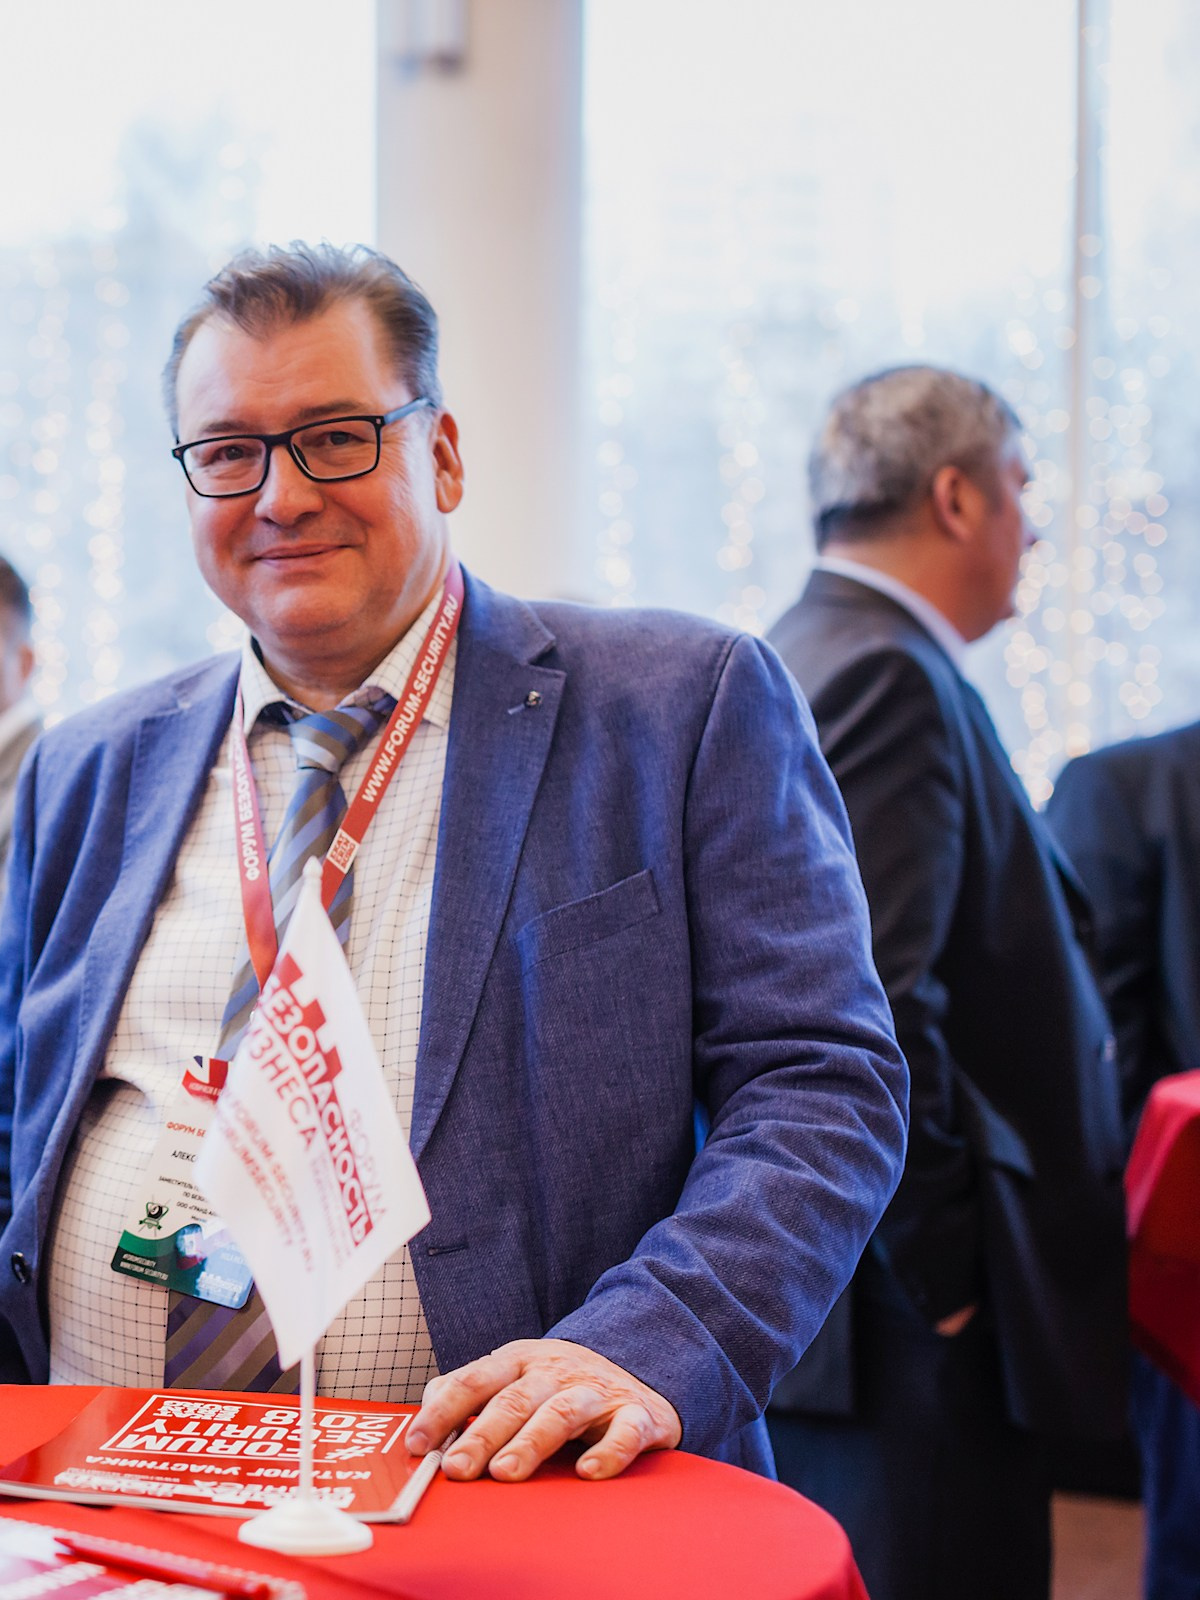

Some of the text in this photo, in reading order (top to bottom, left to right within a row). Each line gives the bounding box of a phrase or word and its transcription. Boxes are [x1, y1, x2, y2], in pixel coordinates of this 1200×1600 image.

[361, 594, 458, 803] WWW.FORUM-SECURITY.RU
[240, 822, 260, 881] ФОРУМ
[166, 1121, 195, 1135] ФОРУМ
[171, 1150, 196, 1162] АЛЕКС
[133, 1418, 386, 1445] SECURITY
[86, 1455, 242, 1476] УЧАСТНИКА
[246, 1468, 372, 1480] КАТЛОГ
